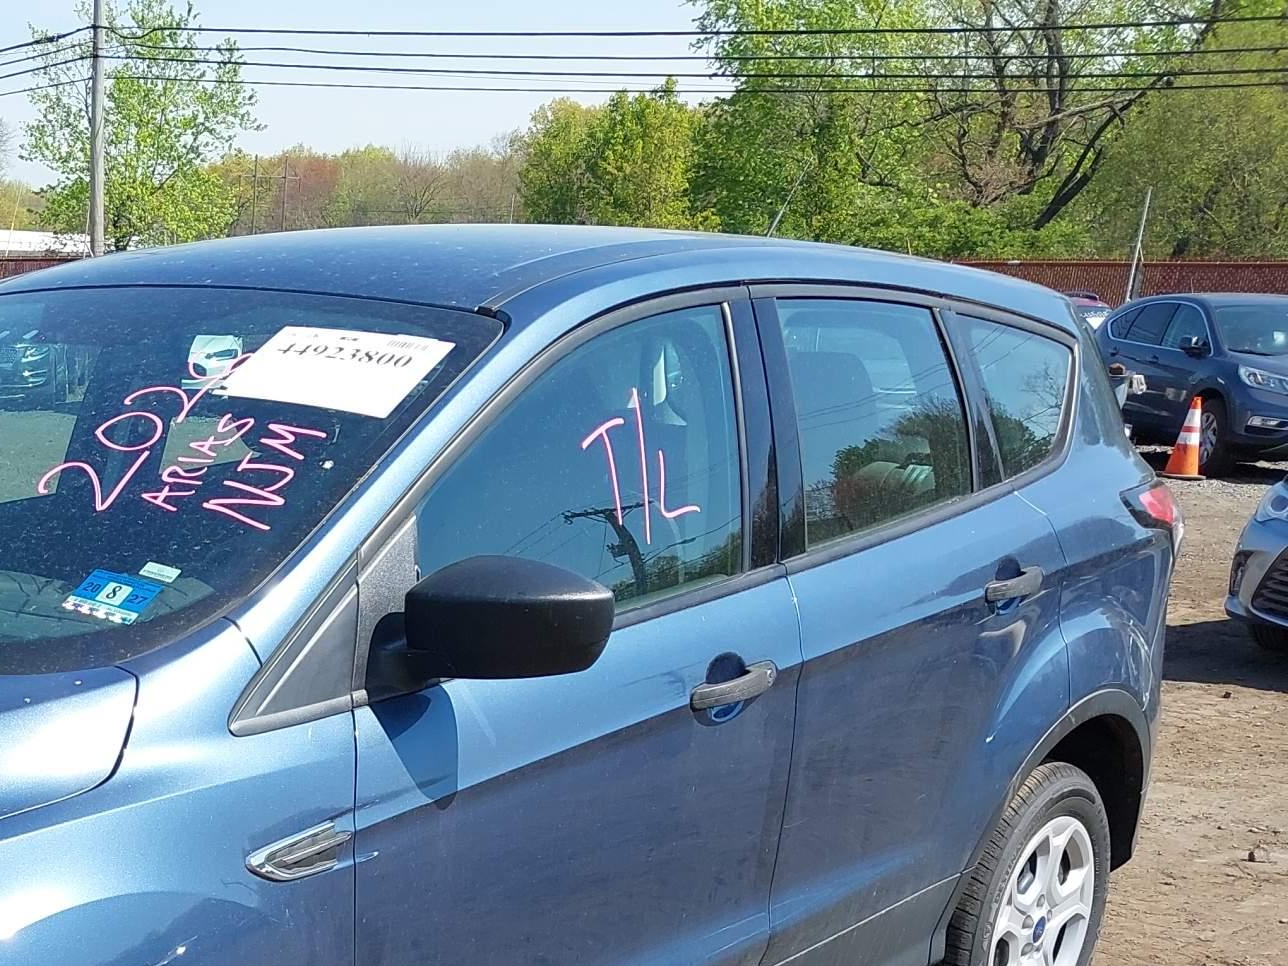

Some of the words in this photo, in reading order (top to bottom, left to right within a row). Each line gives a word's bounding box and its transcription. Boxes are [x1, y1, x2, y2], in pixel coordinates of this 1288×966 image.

[277, 342, 414, 368] 44923800
[140, 412, 256, 512] ARIAS
[581, 386, 701, 545] T/L
[202, 423, 327, 530] NJM
[83, 581, 103, 594] 20
[106, 584, 122, 600] 8
[128, 593, 146, 606] 27
